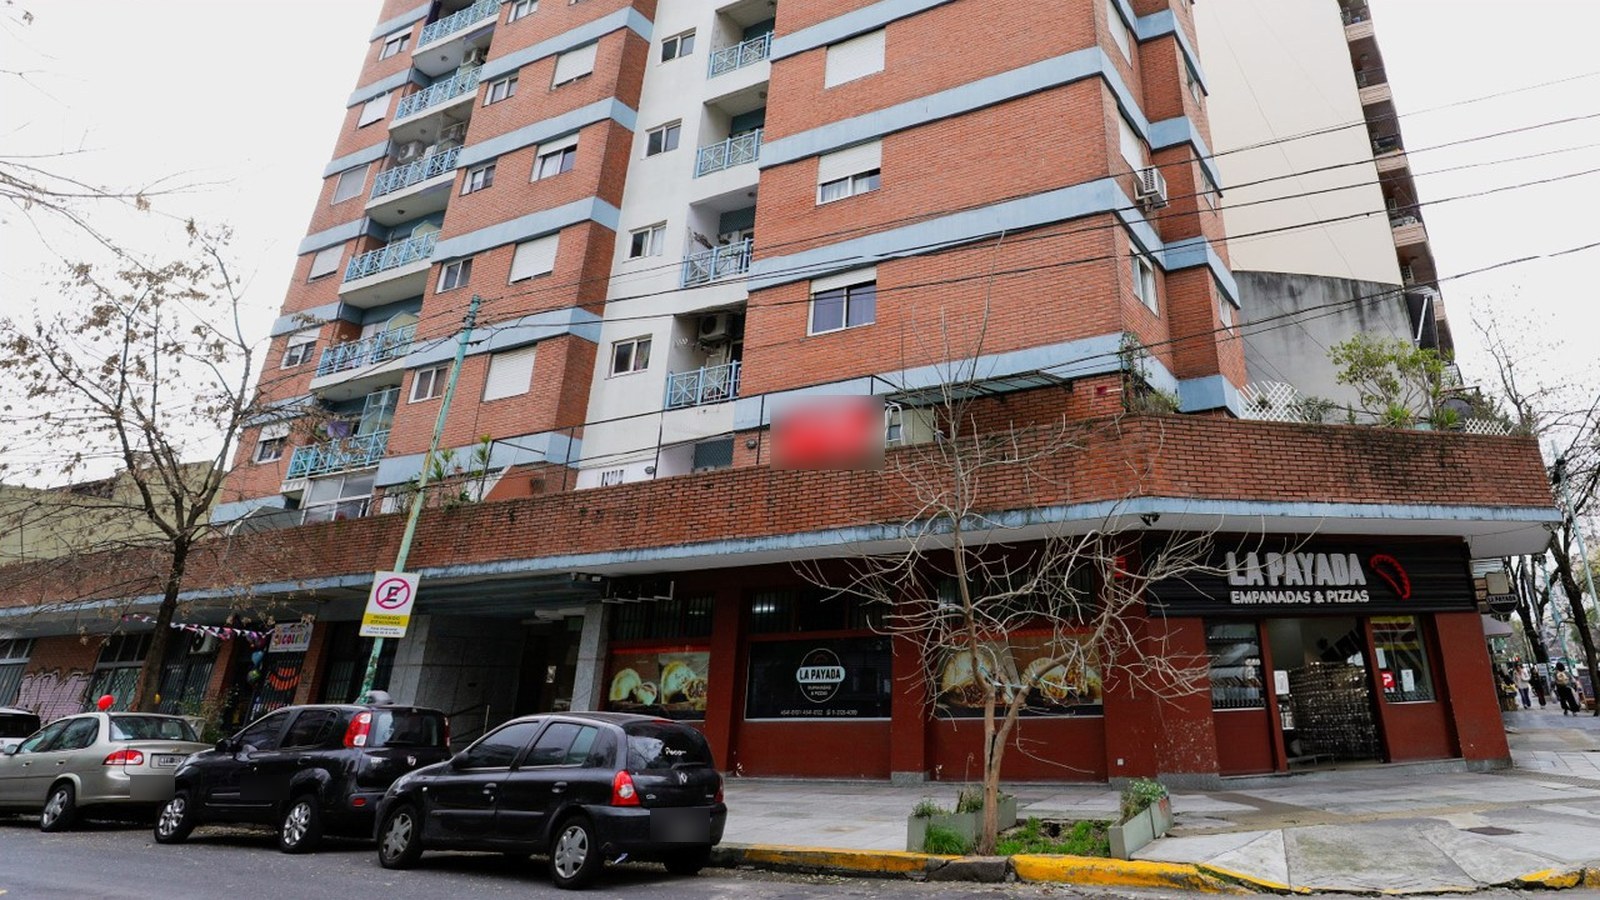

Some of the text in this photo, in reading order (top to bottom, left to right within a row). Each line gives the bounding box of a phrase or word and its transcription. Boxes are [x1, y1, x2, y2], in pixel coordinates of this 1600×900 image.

[1226, 551, 1367, 586] LA PAYADA
[1231, 590, 1370, 604] EMPANADAS & PIZZAS
[800, 669, 840, 680] LA PAYADA
